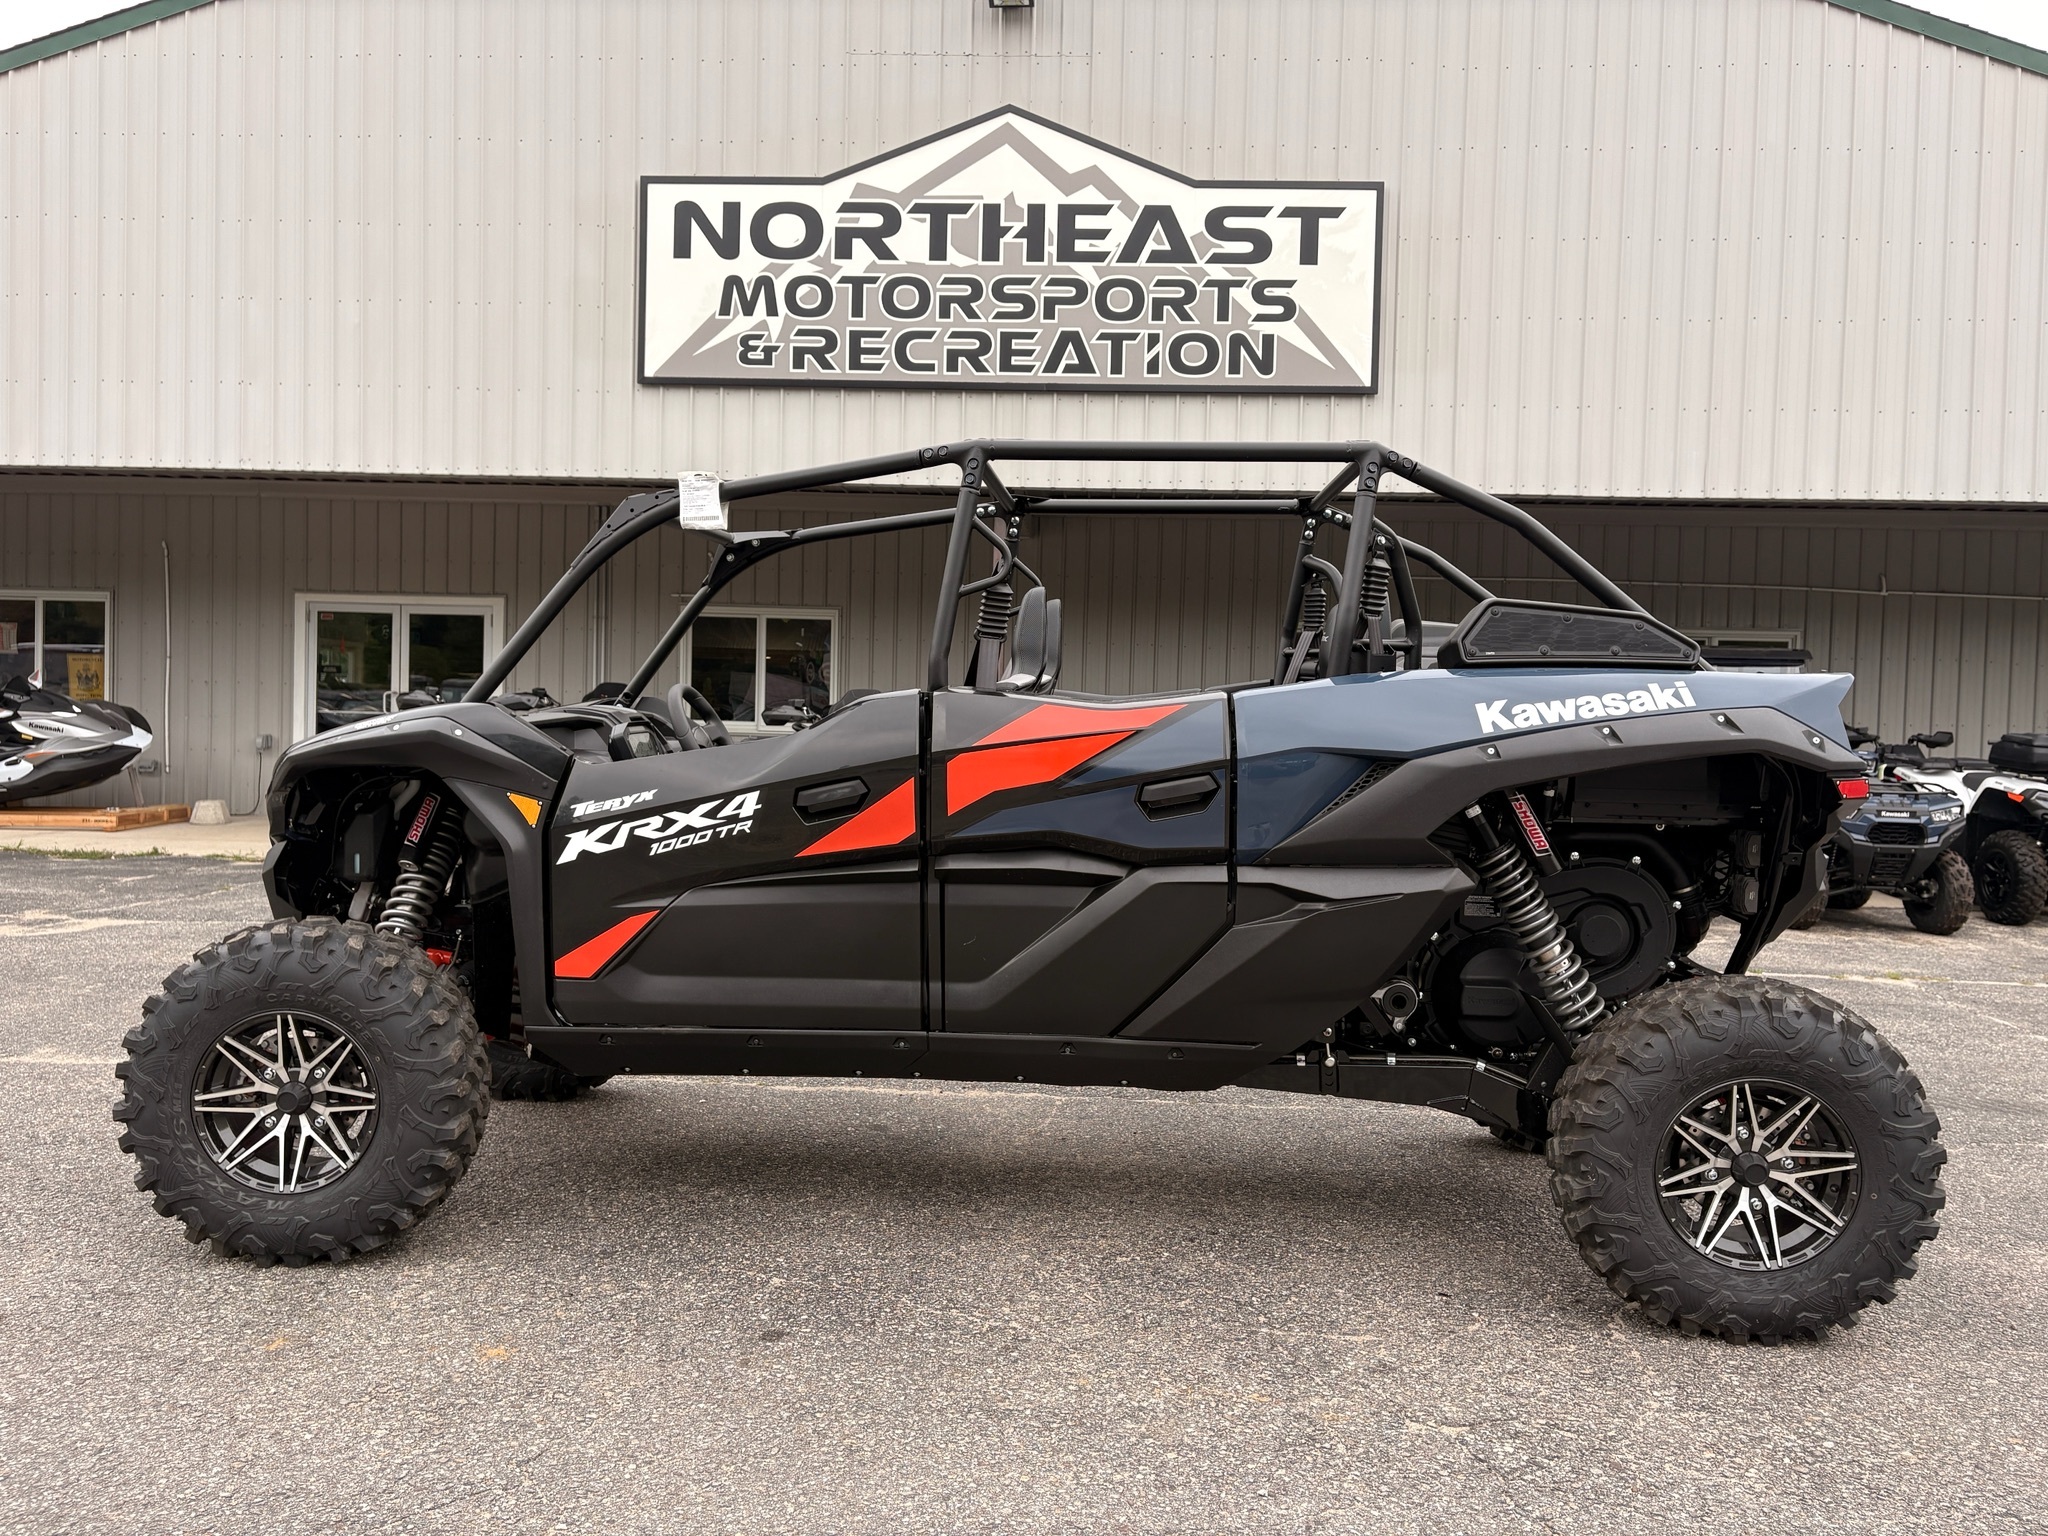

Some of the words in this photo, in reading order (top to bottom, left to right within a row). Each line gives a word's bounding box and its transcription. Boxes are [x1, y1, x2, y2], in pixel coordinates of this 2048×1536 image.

[673, 200, 1346, 267] NORTHEAST
[718, 275, 1298, 323] MOTORSPORTS
[28, 721, 64, 734] Kawasaki
[1474, 680, 1697, 734] Kawasaki
[408, 796, 436, 844] SHOWA
[1511, 800, 1549, 850] SHOWA
[1881, 810, 1910, 818] Kawasaki
